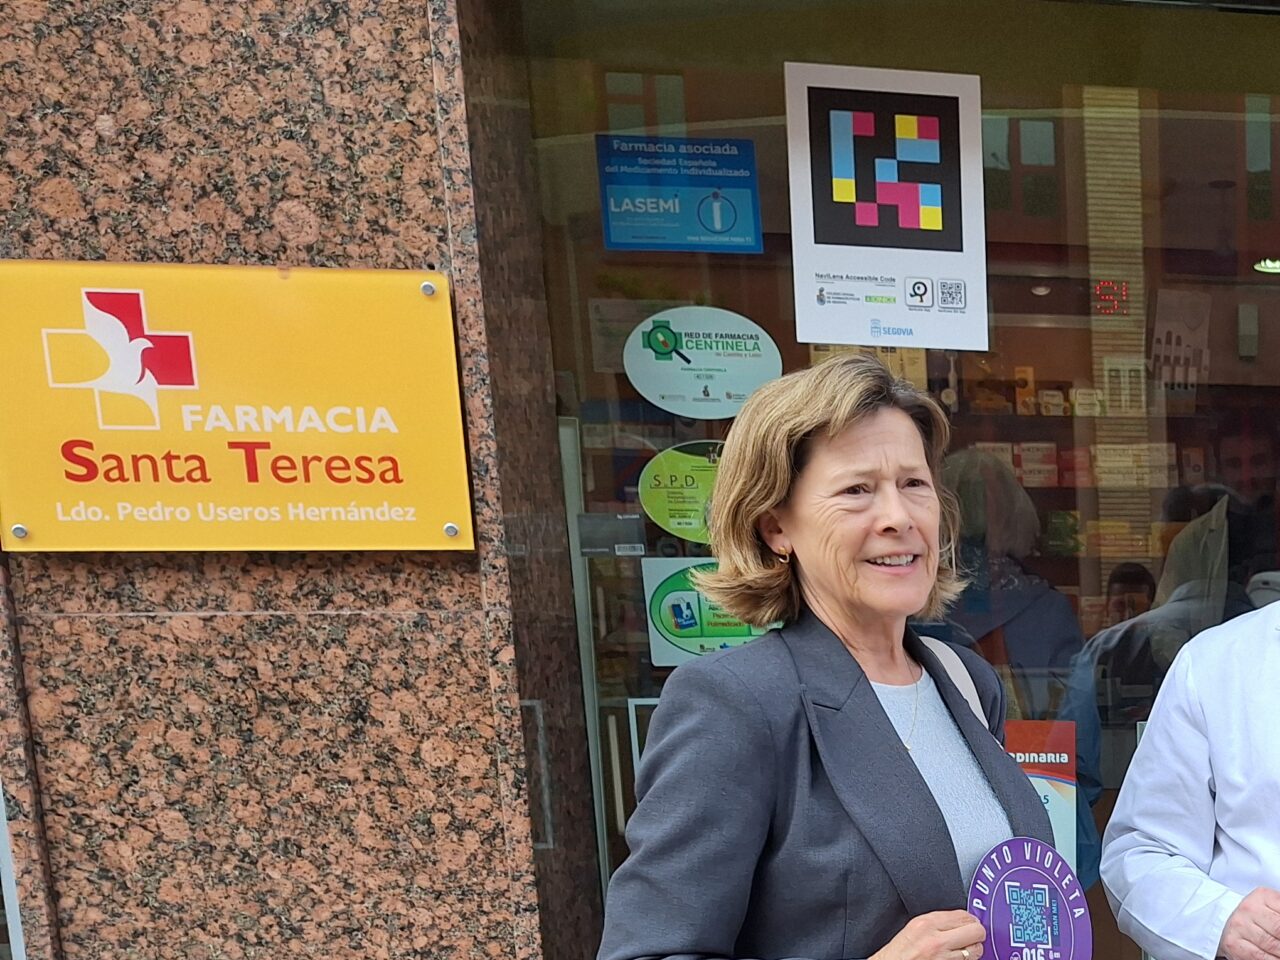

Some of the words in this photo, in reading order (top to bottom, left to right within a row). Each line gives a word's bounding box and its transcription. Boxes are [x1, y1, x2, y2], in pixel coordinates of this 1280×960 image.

[612, 140, 676, 153] Farmacia
[678, 143, 739, 155] asociada
[680, 168, 750, 177] Individualizado
[882, 326, 914, 336] SEGOVIA
[686, 340, 761, 352] CENTINELA
[181, 404, 399, 433] FARMACIA
[60, 440, 212, 484] Santa
[227, 441, 404, 484] Teresa
[56, 502, 110, 522] Ldo.
[118, 502, 190, 522] Pedro
[198, 502, 281, 522] Useros
[288, 502, 416, 522] Hernández
[972, 846, 1012, 911] PUNTO
[1024, 842, 1084, 919] VIOLETA
